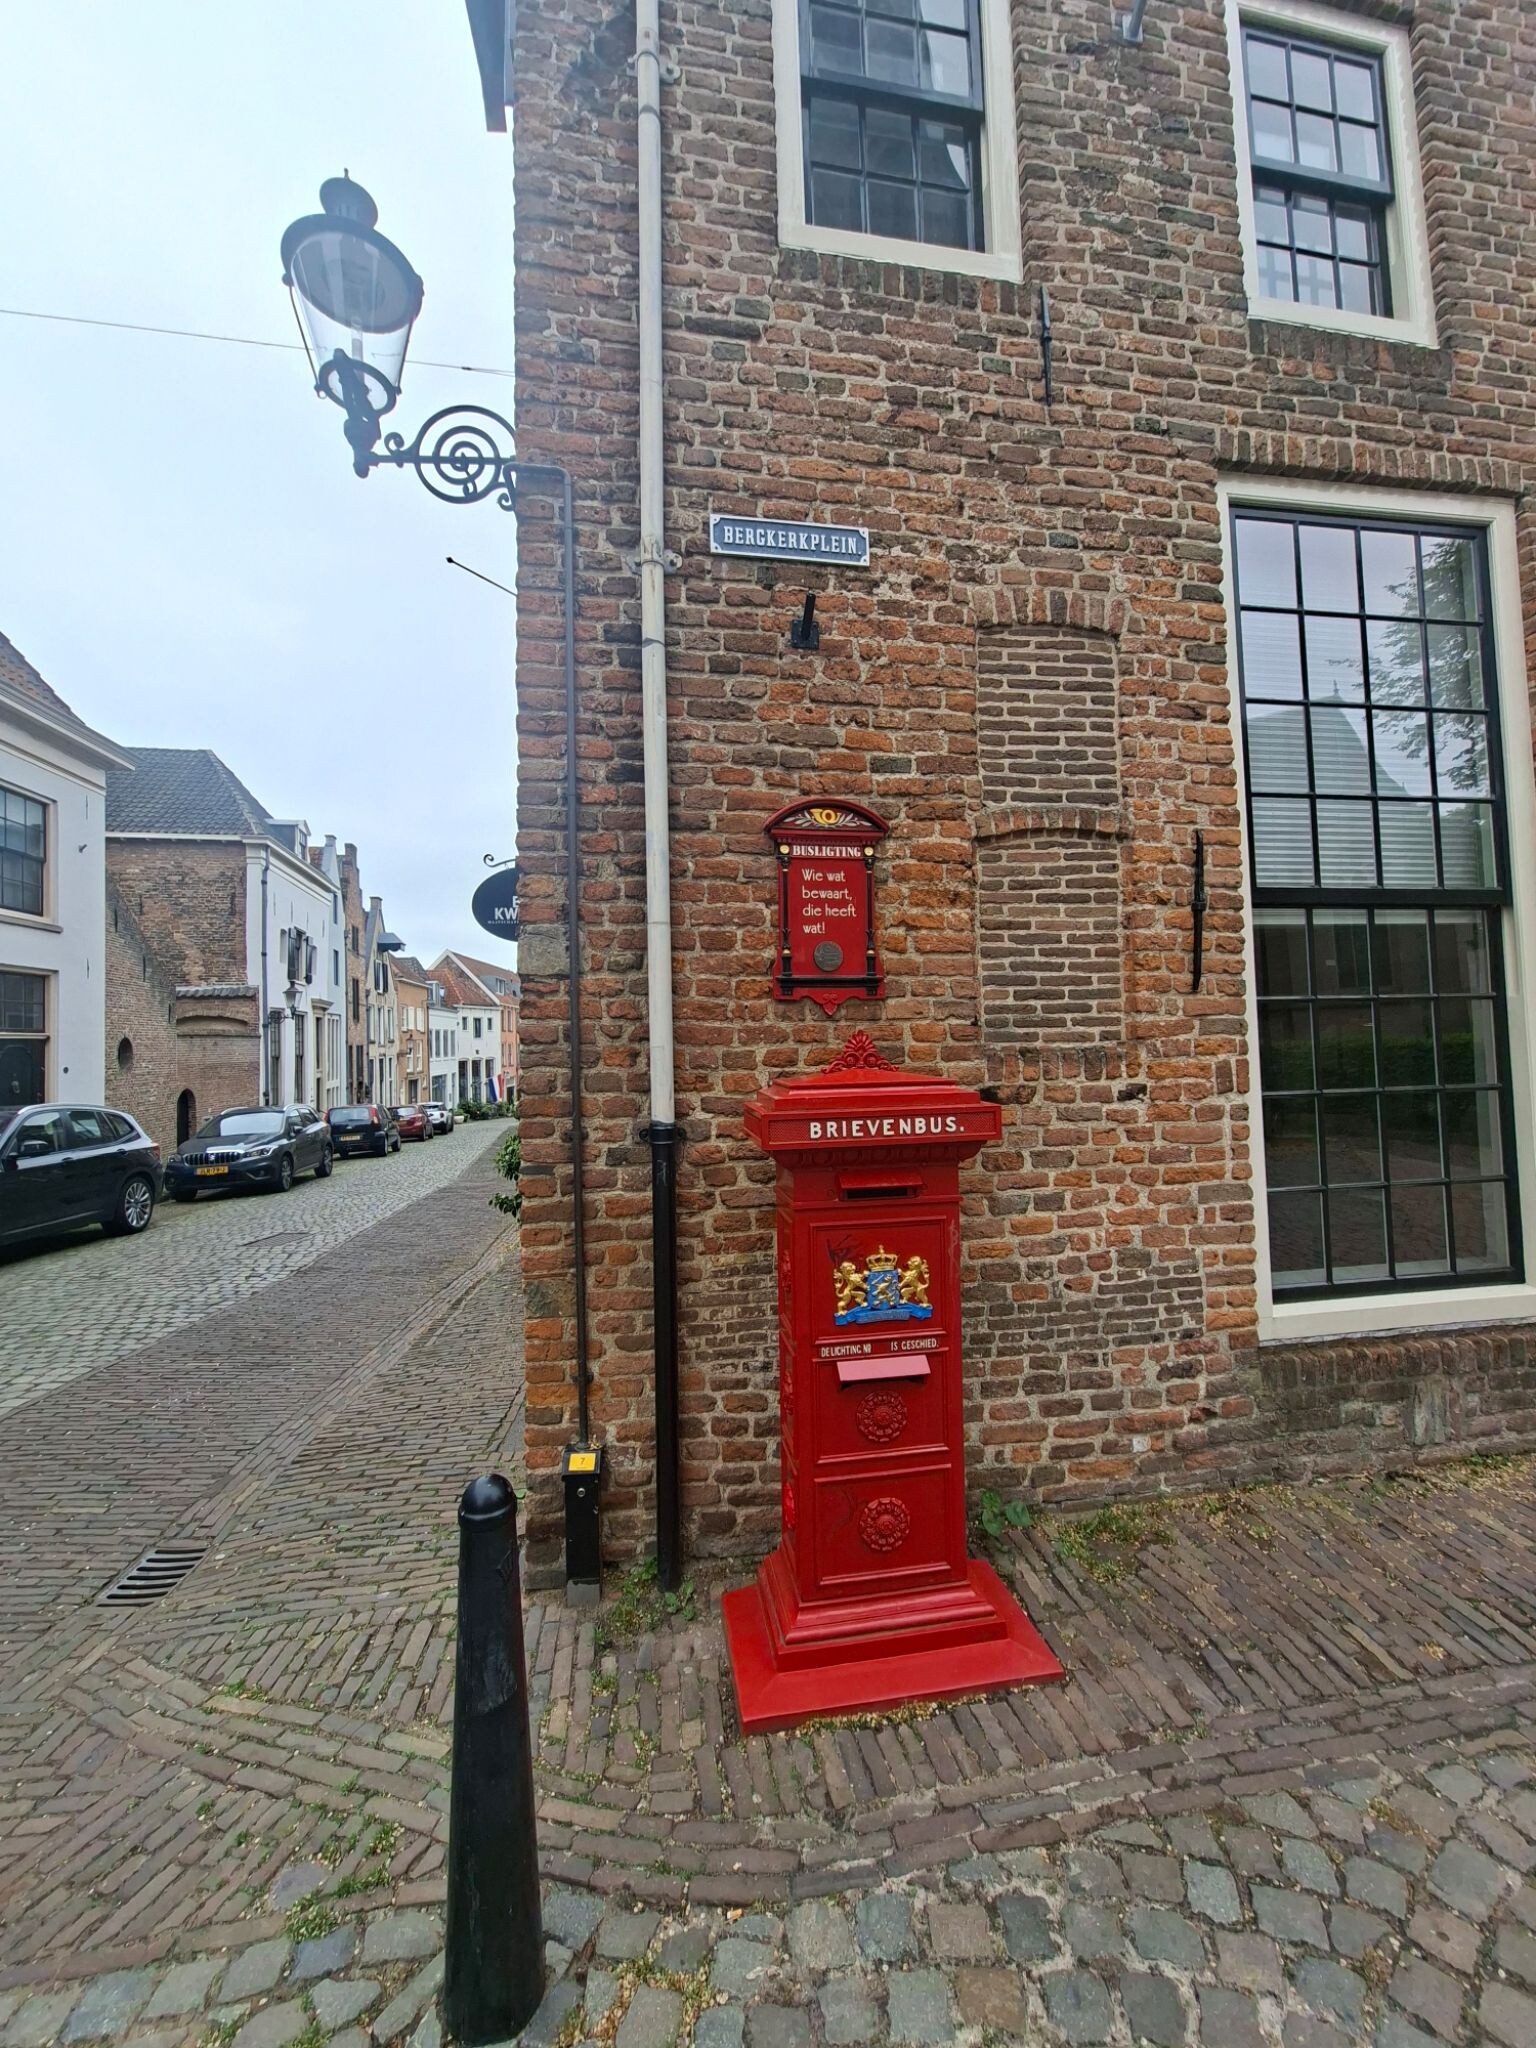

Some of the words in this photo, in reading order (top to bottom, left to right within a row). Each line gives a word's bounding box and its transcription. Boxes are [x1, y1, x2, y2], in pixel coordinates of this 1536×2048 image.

[792, 844, 861, 858] BUSLIGTING
[801, 868, 824, 882] Wie
[826, 869, 846, 882] wat
[802, 886, 853, 901] bewaart,
[802, 903, 823, 917] die
[824, 903, 857, 918] heeft
[802, 921, 826, 934] wat!
[809, 1116, 965, 1139] BRIEVENBUS.
[821, 1347, 830, 1357] DE
[890, 1341, 898, 1351] IS
